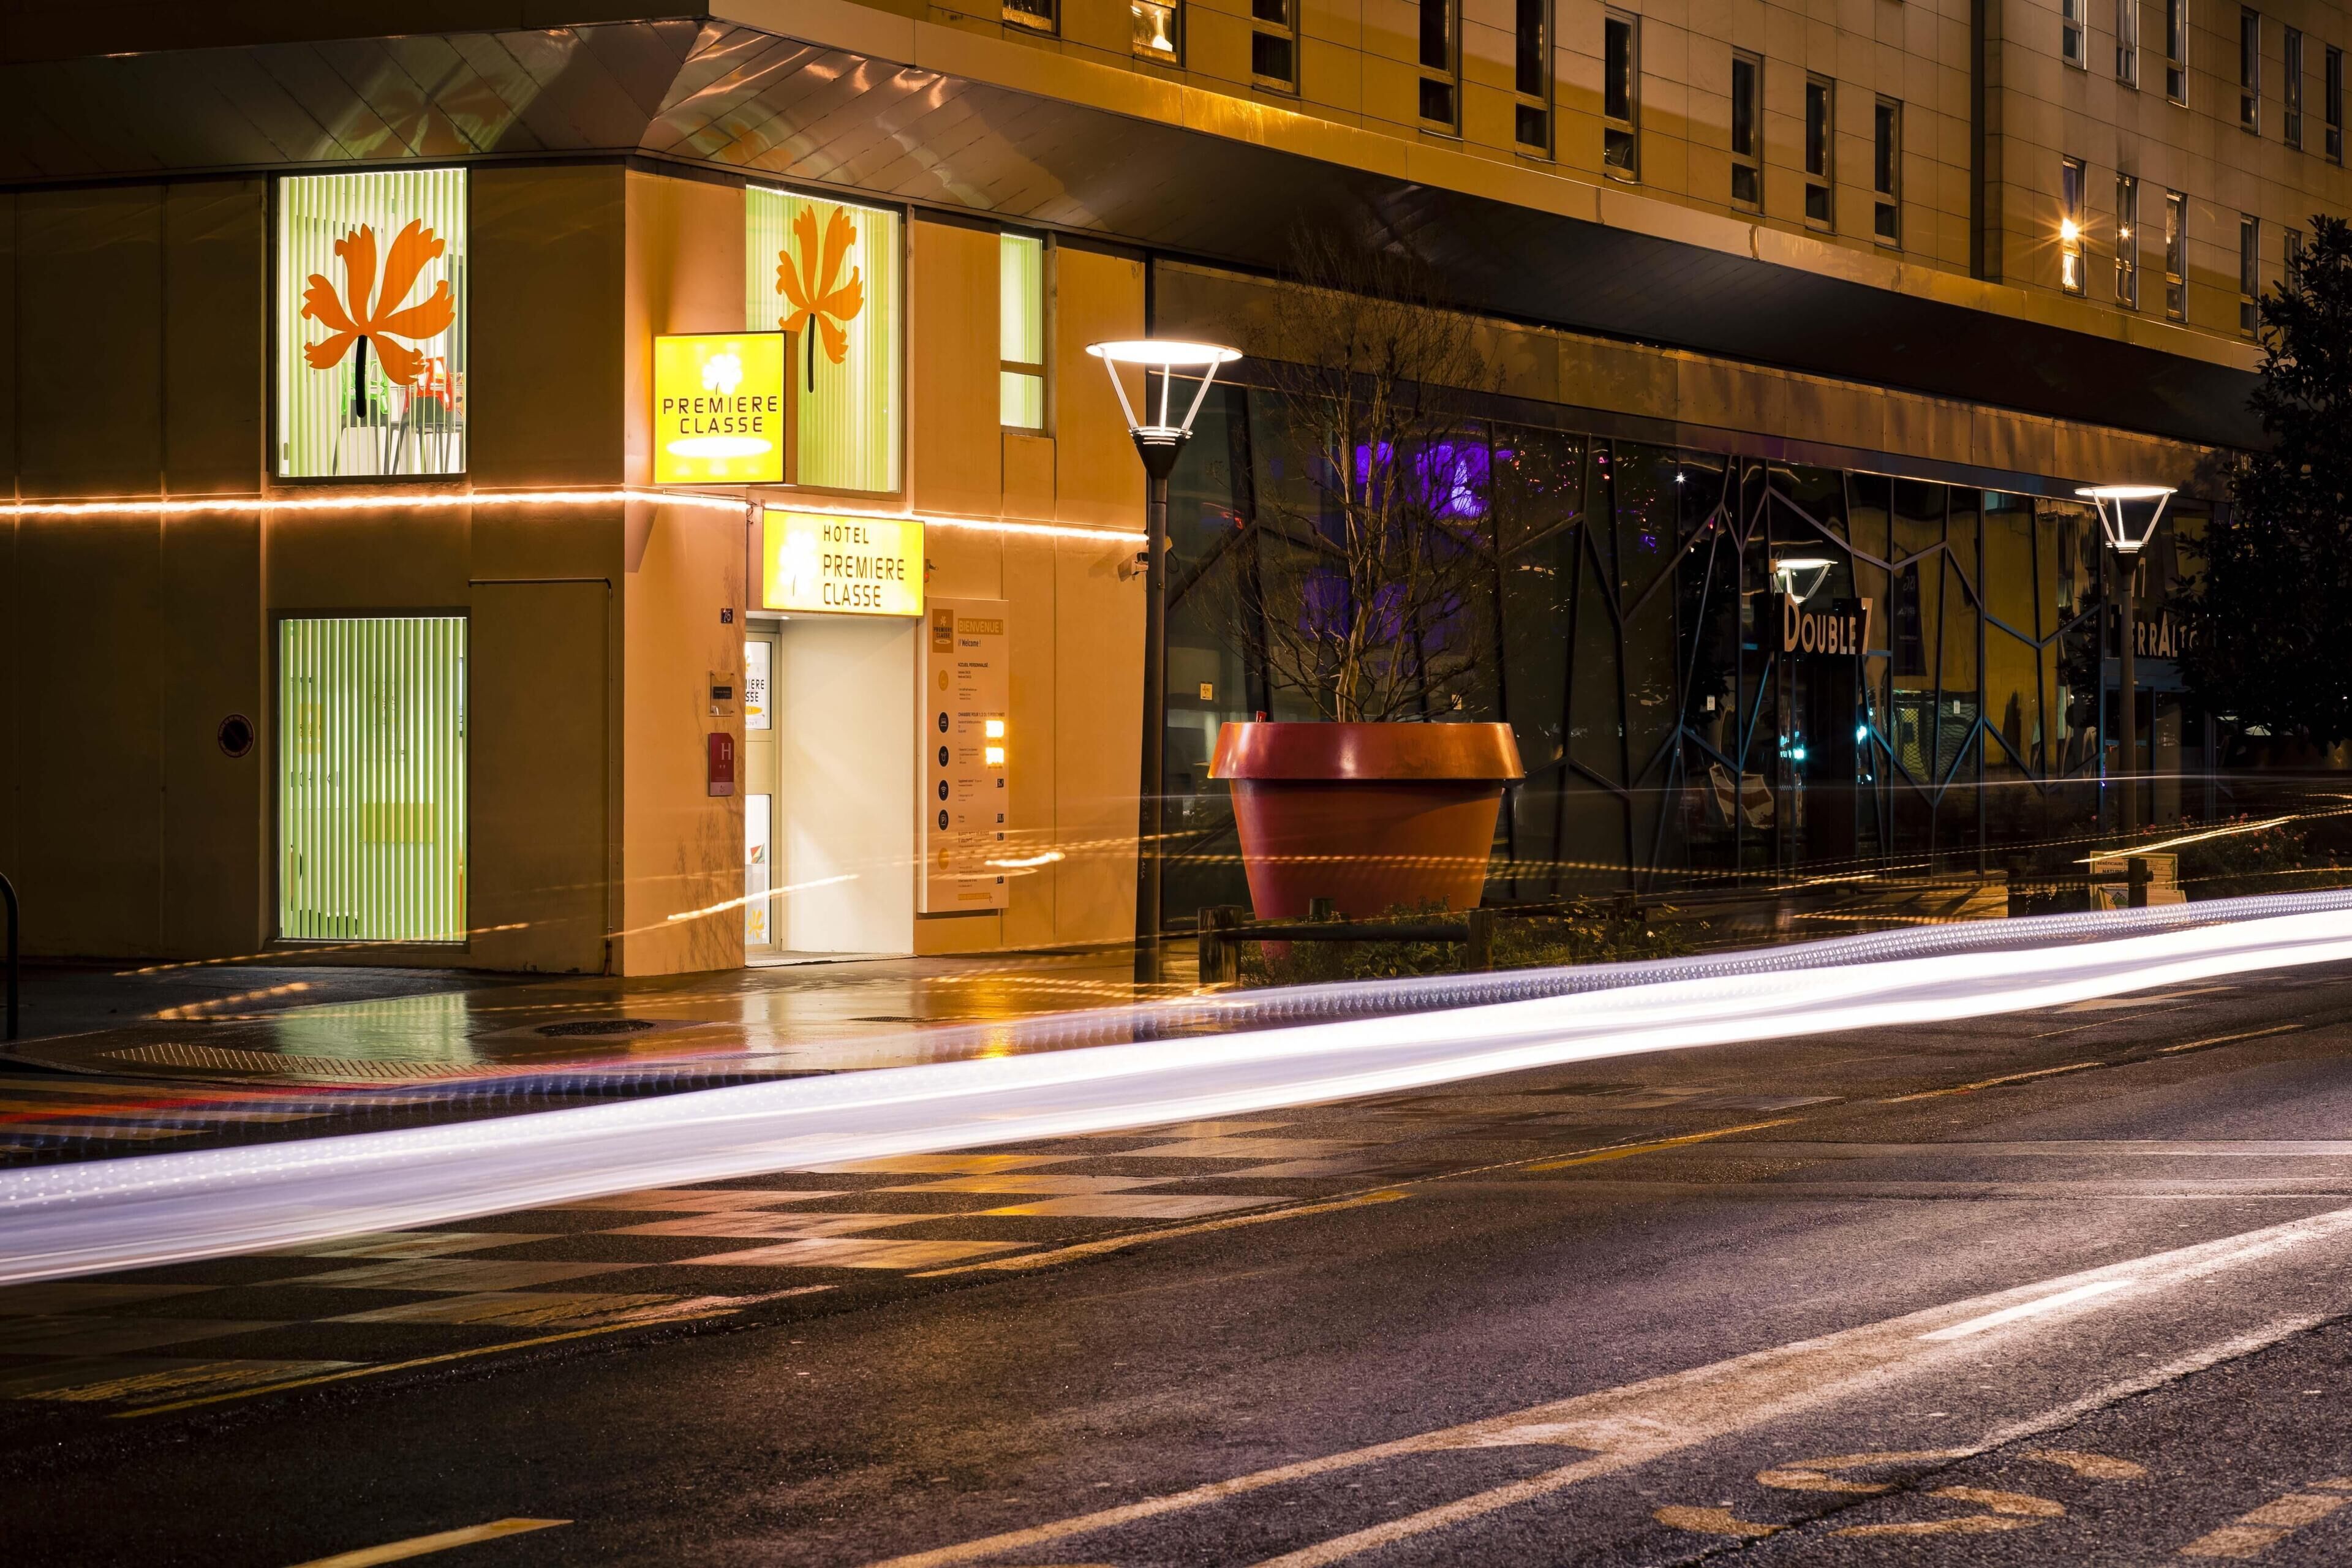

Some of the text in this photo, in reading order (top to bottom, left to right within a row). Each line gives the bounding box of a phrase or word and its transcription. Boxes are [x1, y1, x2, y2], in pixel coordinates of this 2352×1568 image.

[663, 396, 777, 414] PREMIERE
[680, 417, 762, 434] CLASSE
[823, 525, 869, 544] HOTEL
[823, 554, 905, 581] PREMIERE
[824, 583, 881, 607] CLASSE
[959, 620, 1000, 633] BIENVENUE
[962, 638, 979, 647] Welcome
[720, 742, 731, 760] H
